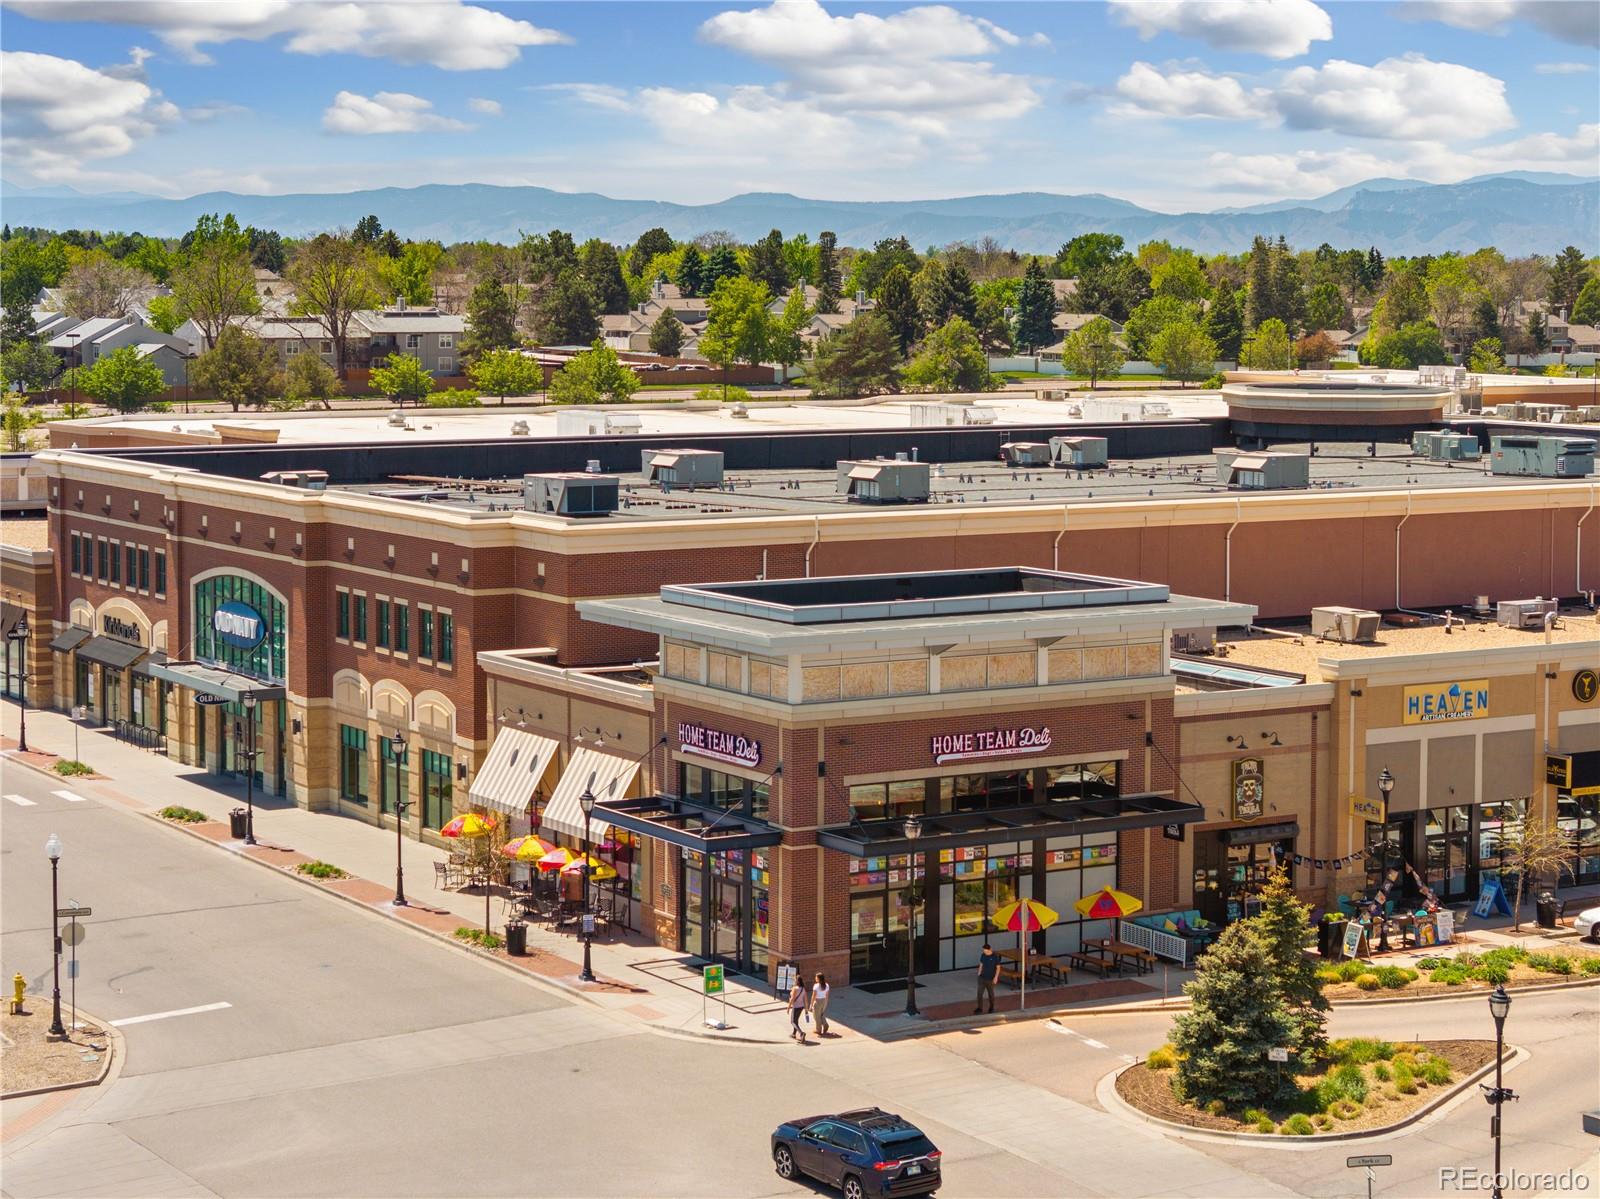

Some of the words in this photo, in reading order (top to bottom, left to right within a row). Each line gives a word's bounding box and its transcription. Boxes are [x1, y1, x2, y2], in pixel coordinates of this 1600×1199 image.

[215, 610, 233, 632] OLD
[232, 615, 258, 640] NAVY
[199, 695, 214, 703] OLD
[1408, 684, 1488, 716] HEAVEN
[678, 723, 706, 747] HOME
[706, 730, 734, 755] TEAM
[735, 736, 760, 760] Deli
[932, 734, 974, 754] HOME
[976, 730, 1017, 751] TEAM
[1018, 727, 1052, 747] Deli
